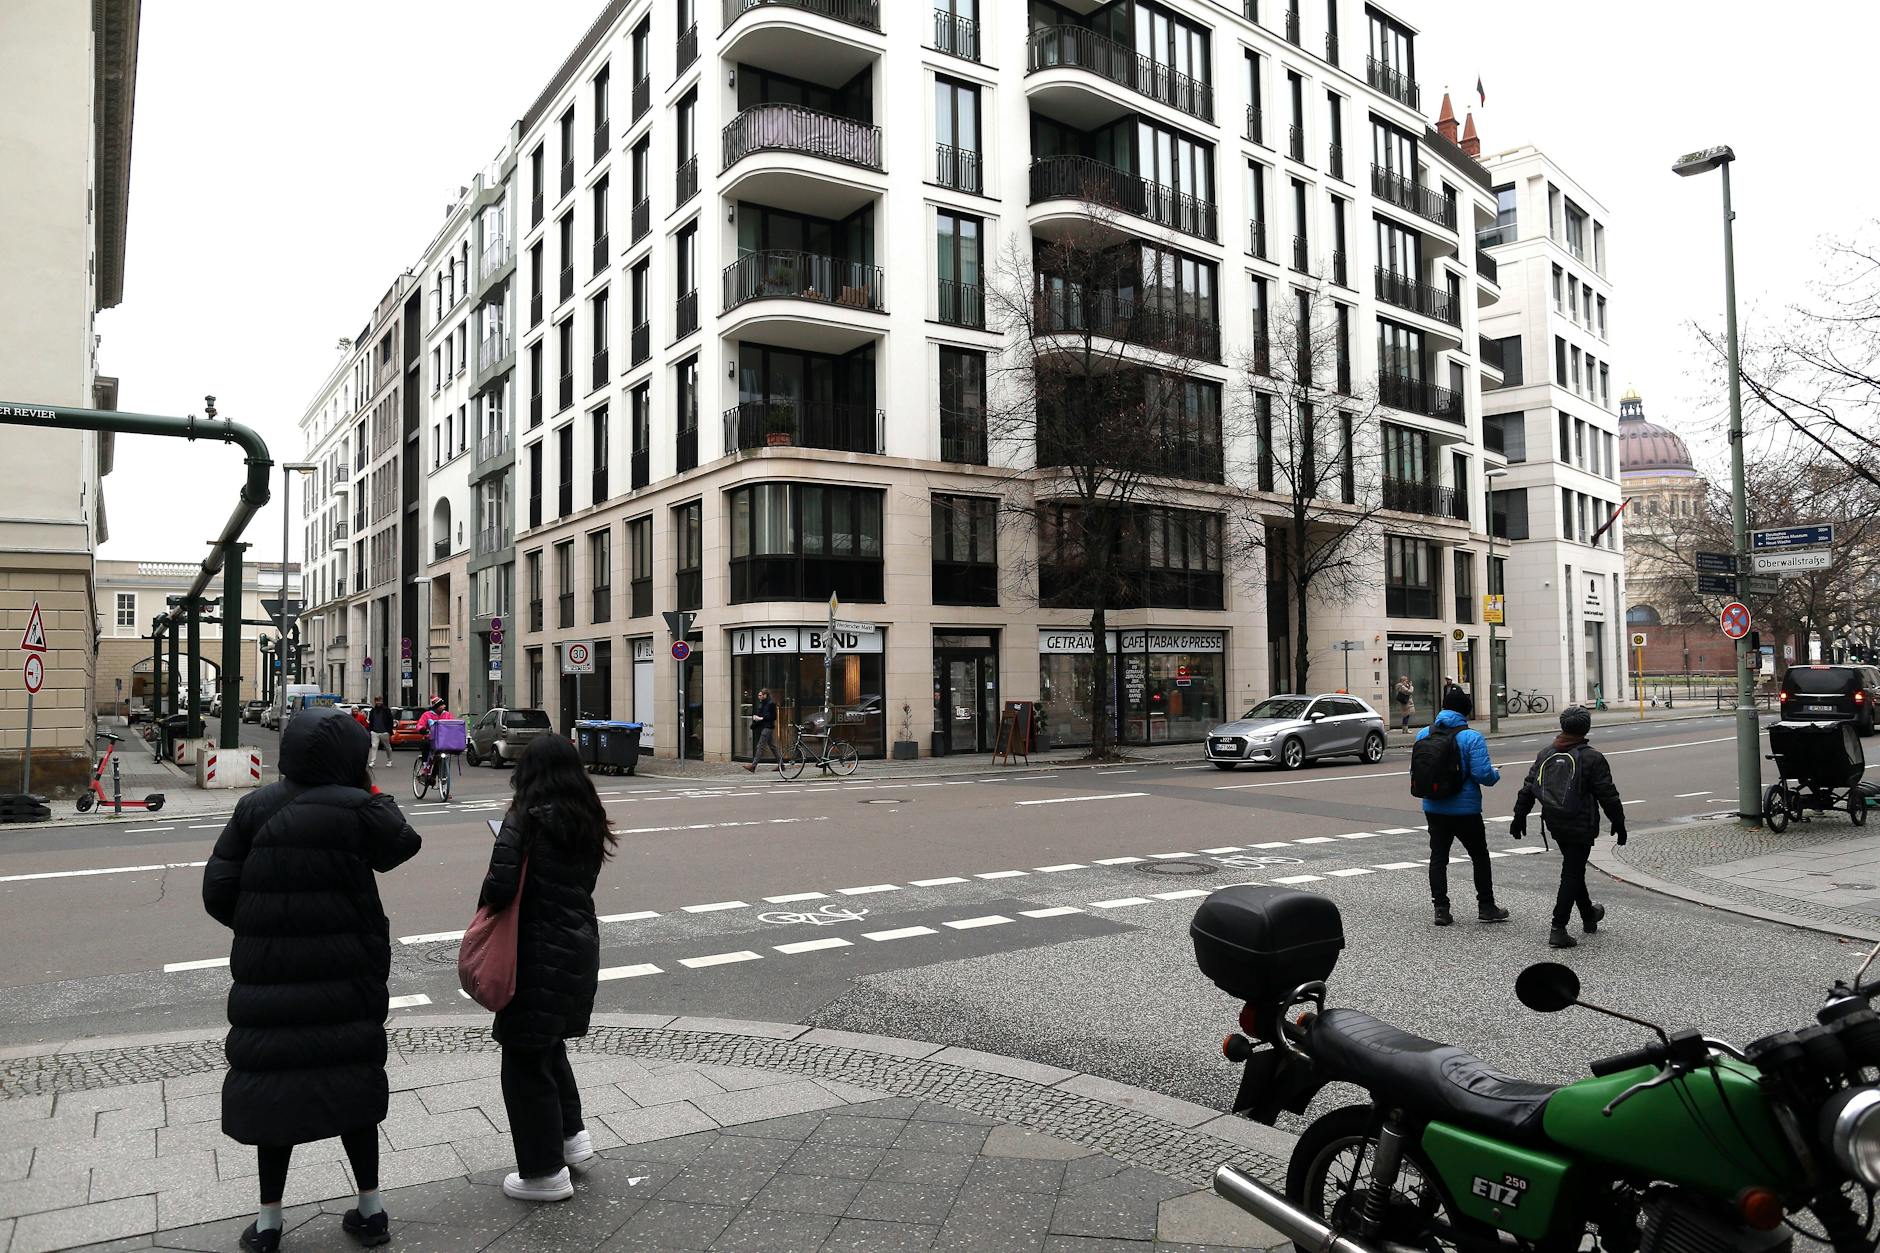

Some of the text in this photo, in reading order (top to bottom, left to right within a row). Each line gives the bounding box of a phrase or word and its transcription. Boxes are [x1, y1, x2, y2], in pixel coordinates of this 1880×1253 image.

[14, 408, 56, 419] REVIER
[1758, 556, 1825, 568] Oberwallstraße
[760, 634, 787, 648] the
[1047, 633, 1106, 649] GETRÄN
[1149, 635, 1222, 648] TABAK & PRESSE
[573, 649, 585, 659] 30
[1505, 1175, 1527, 1190] 250
